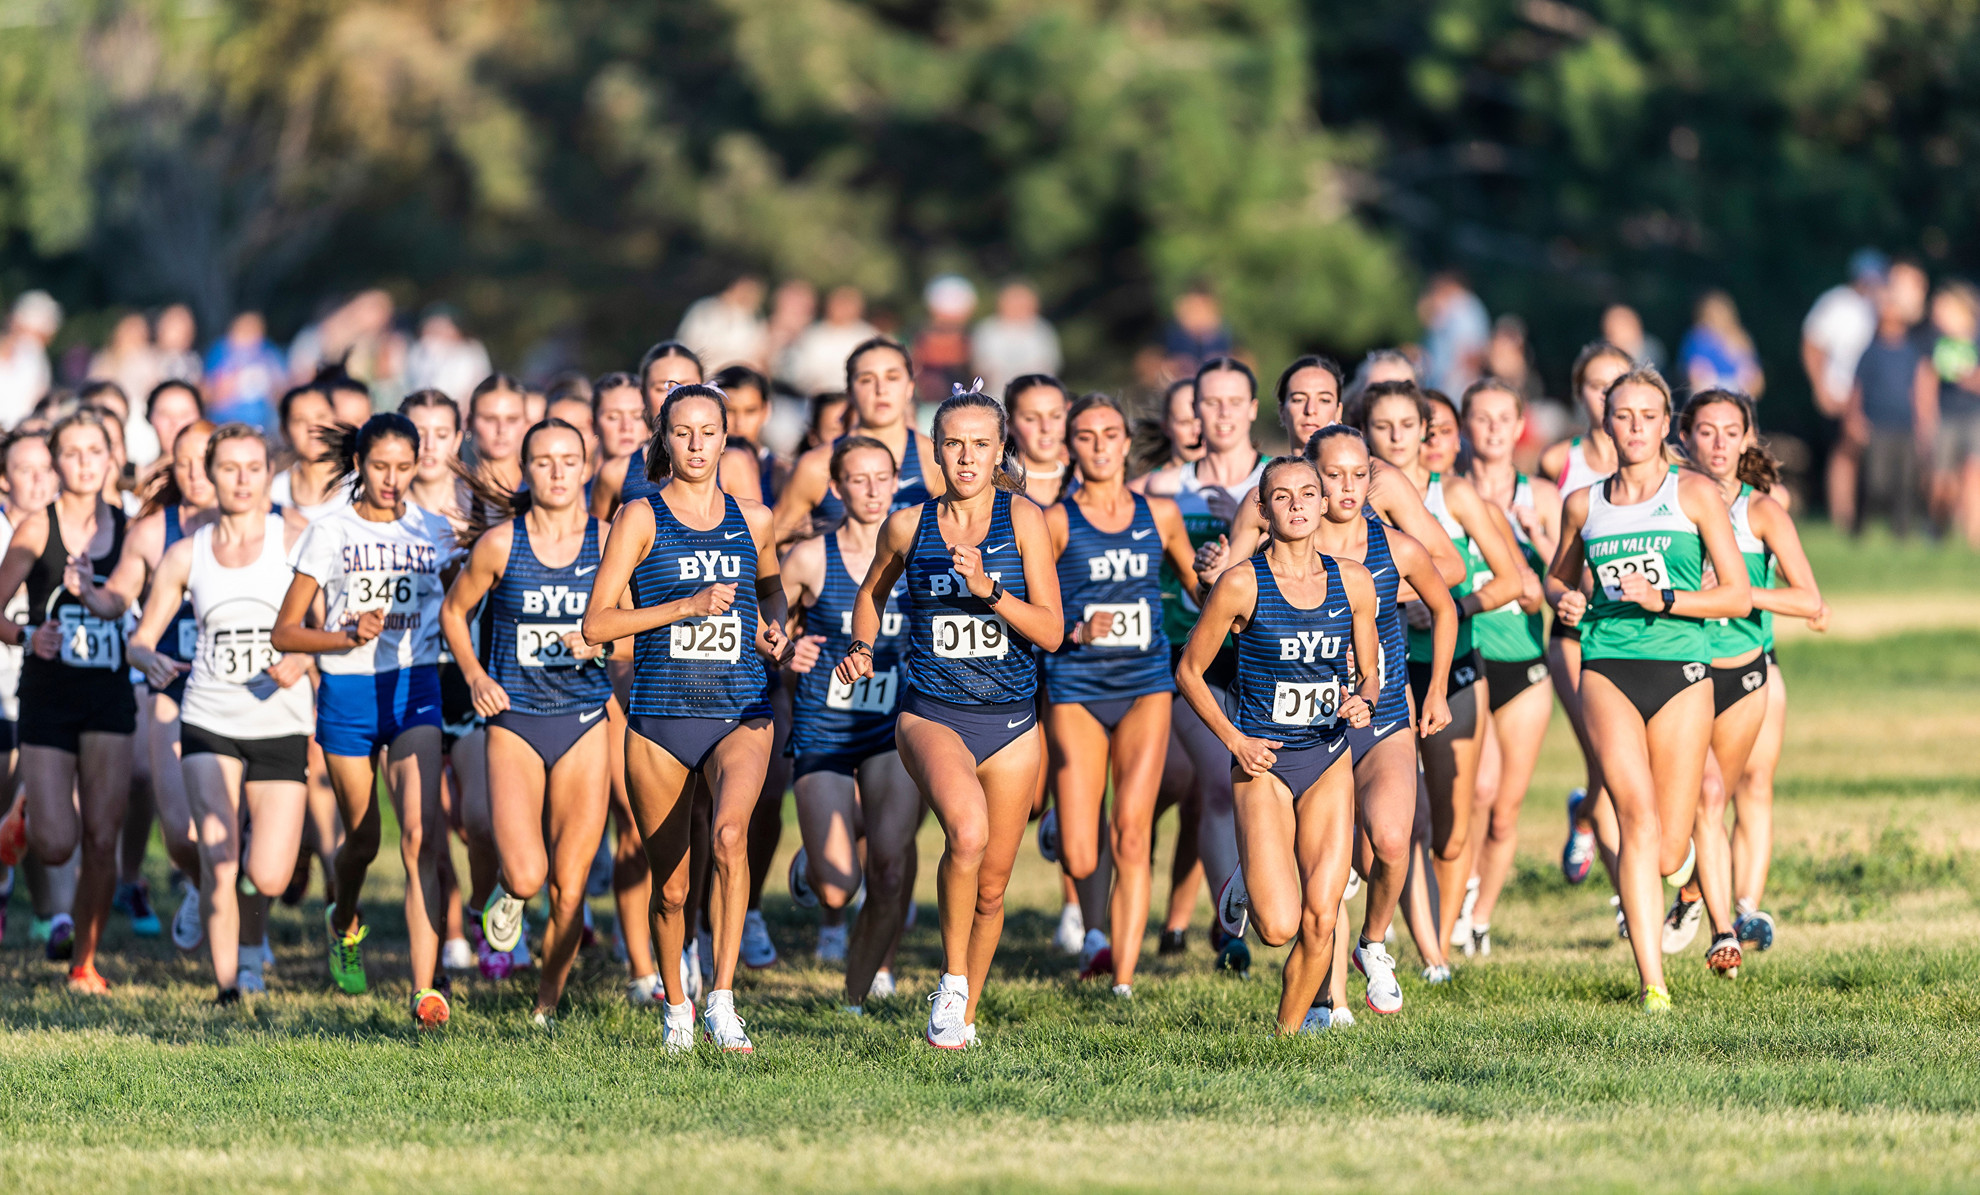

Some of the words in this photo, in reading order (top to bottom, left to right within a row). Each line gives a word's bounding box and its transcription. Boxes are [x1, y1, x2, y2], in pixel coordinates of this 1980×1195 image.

[342, 543, 386, 574] SALT
[391, 543, 437, 574] LAKE
[1589, 540, 1620, 559] UTAH
[1622, 536, 1672, 553] VALLEY
[678, 550, 741, 582] BYU
[1088, 548, 1149, 582] BYU
[359, 576, 412, 604] 346
[929, 568, 1002, 598] BY
[522, 585, 588, 618] BYU
[682, 621, 736, 652] 025
[944, 620, 1002, 651] 019
[1111, 610, 1141, 637] 31
[225, 648, 273, 675] 313
[1279, 631, 1341, 663] BYU
[1285, 688, 1335, 718] 018
